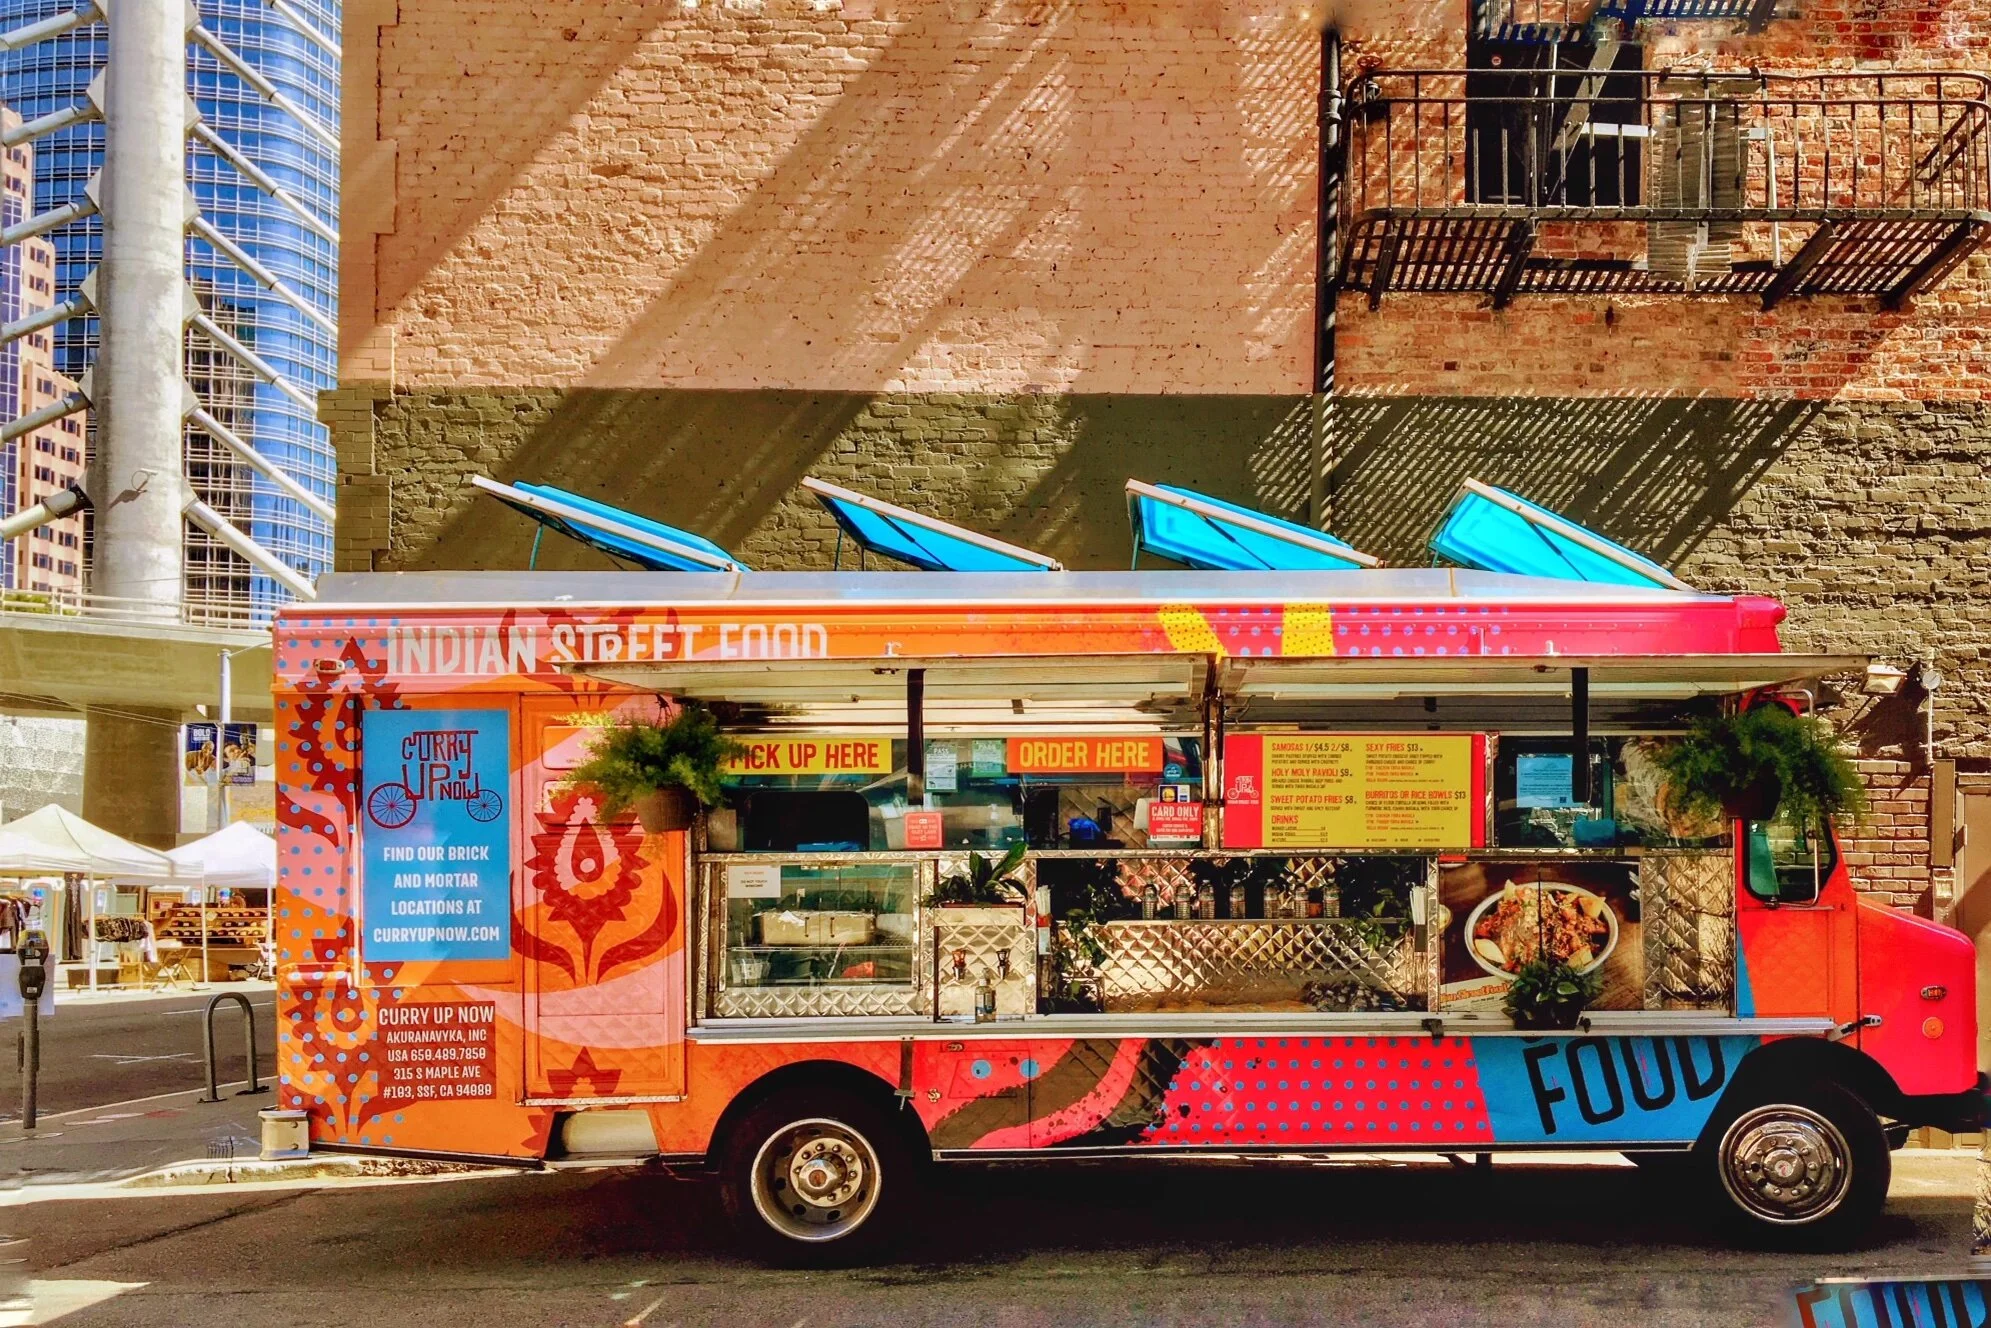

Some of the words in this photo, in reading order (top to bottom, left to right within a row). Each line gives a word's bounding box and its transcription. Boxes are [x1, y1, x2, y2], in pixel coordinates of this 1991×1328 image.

[387, 624, 536, 675] INDIAN
[551, 623, 702, 662] STREET
[719, 623, 829, 659] FOOD
[1020, 741, 1088, 768] ORDER
[1096, 741, 1150, 768] HERE
[1271, 742, 1304, 752] SAMOSAS
[1366, 743, 1384, 752] SEXY
[1386, 743, 1405, 752] FRIES
[402, 730, 479, 780] CURRY
[788, 743, 817, 768] UP
[825, 742, 880, 769] HERE
[1271, 768, 1290, 777] HOLY
[1291, 768, 1311, 777] MOLY
[1312, 768, 1339, 777] RAVIOLI
[402, 762, 451, 801] UP
[440, 772, 480, 800] NOW
[1270, 795, 1294, 804] SWEET
[1295, 795, 1323, 804] POTATO
[1324, 795, 1343, 804] FRIES
[1365, 791, 1398, 799] BURRITOS
[1399, 791, 1410, 799] OR
[1411, 791, 1426, 799] RICE
[1428, 791, 1453, 799] BOWLS
[1454, 791, 1467, 800] $13
[1151, 806, 1175, 817] CARD
[1177, 806, 1199, 817] ONLY
[1271, 815, 1299, 824] DRINKS
[384, 847, 414, 861] FIND
[417, 847, 445, 861] OUR
[449, 846, 489, 861] BRICK
[394, 874, 421, 888] AND
[425, 873, 478, 888] MORTAR
[391, 900, 464, 915] LOCATIONS
[466, 900, 482, 914] AT
[373, 926, 500, 942] CURRYUPNOW.COM
[380, 1007, 429, 1025] CURRY
[433, 1006, 453, 1024] UP
[458, 1005, 494, 1023] NOW
[386, 1029, 466, 1043] AKURANAVYKA,
[468, 1028, 487, 1041] INC
[387, 1049, 408, 1062] USA
[410, 1047, 486, 1061] 650.489.7850
[393, 1067, 413, 1080] 315
[415, 1067, 423, 1079] S
[425, 1066, 460, 1079] MAPLE
[462, 1065, 481, 1078] AVE
[383, 1085, 415, 1099] #103,
[416, 1084, 438, 1098] SSF,
[439, 1084, 454, 1097] CA
[456, 1083, 492, 1096] 94080
